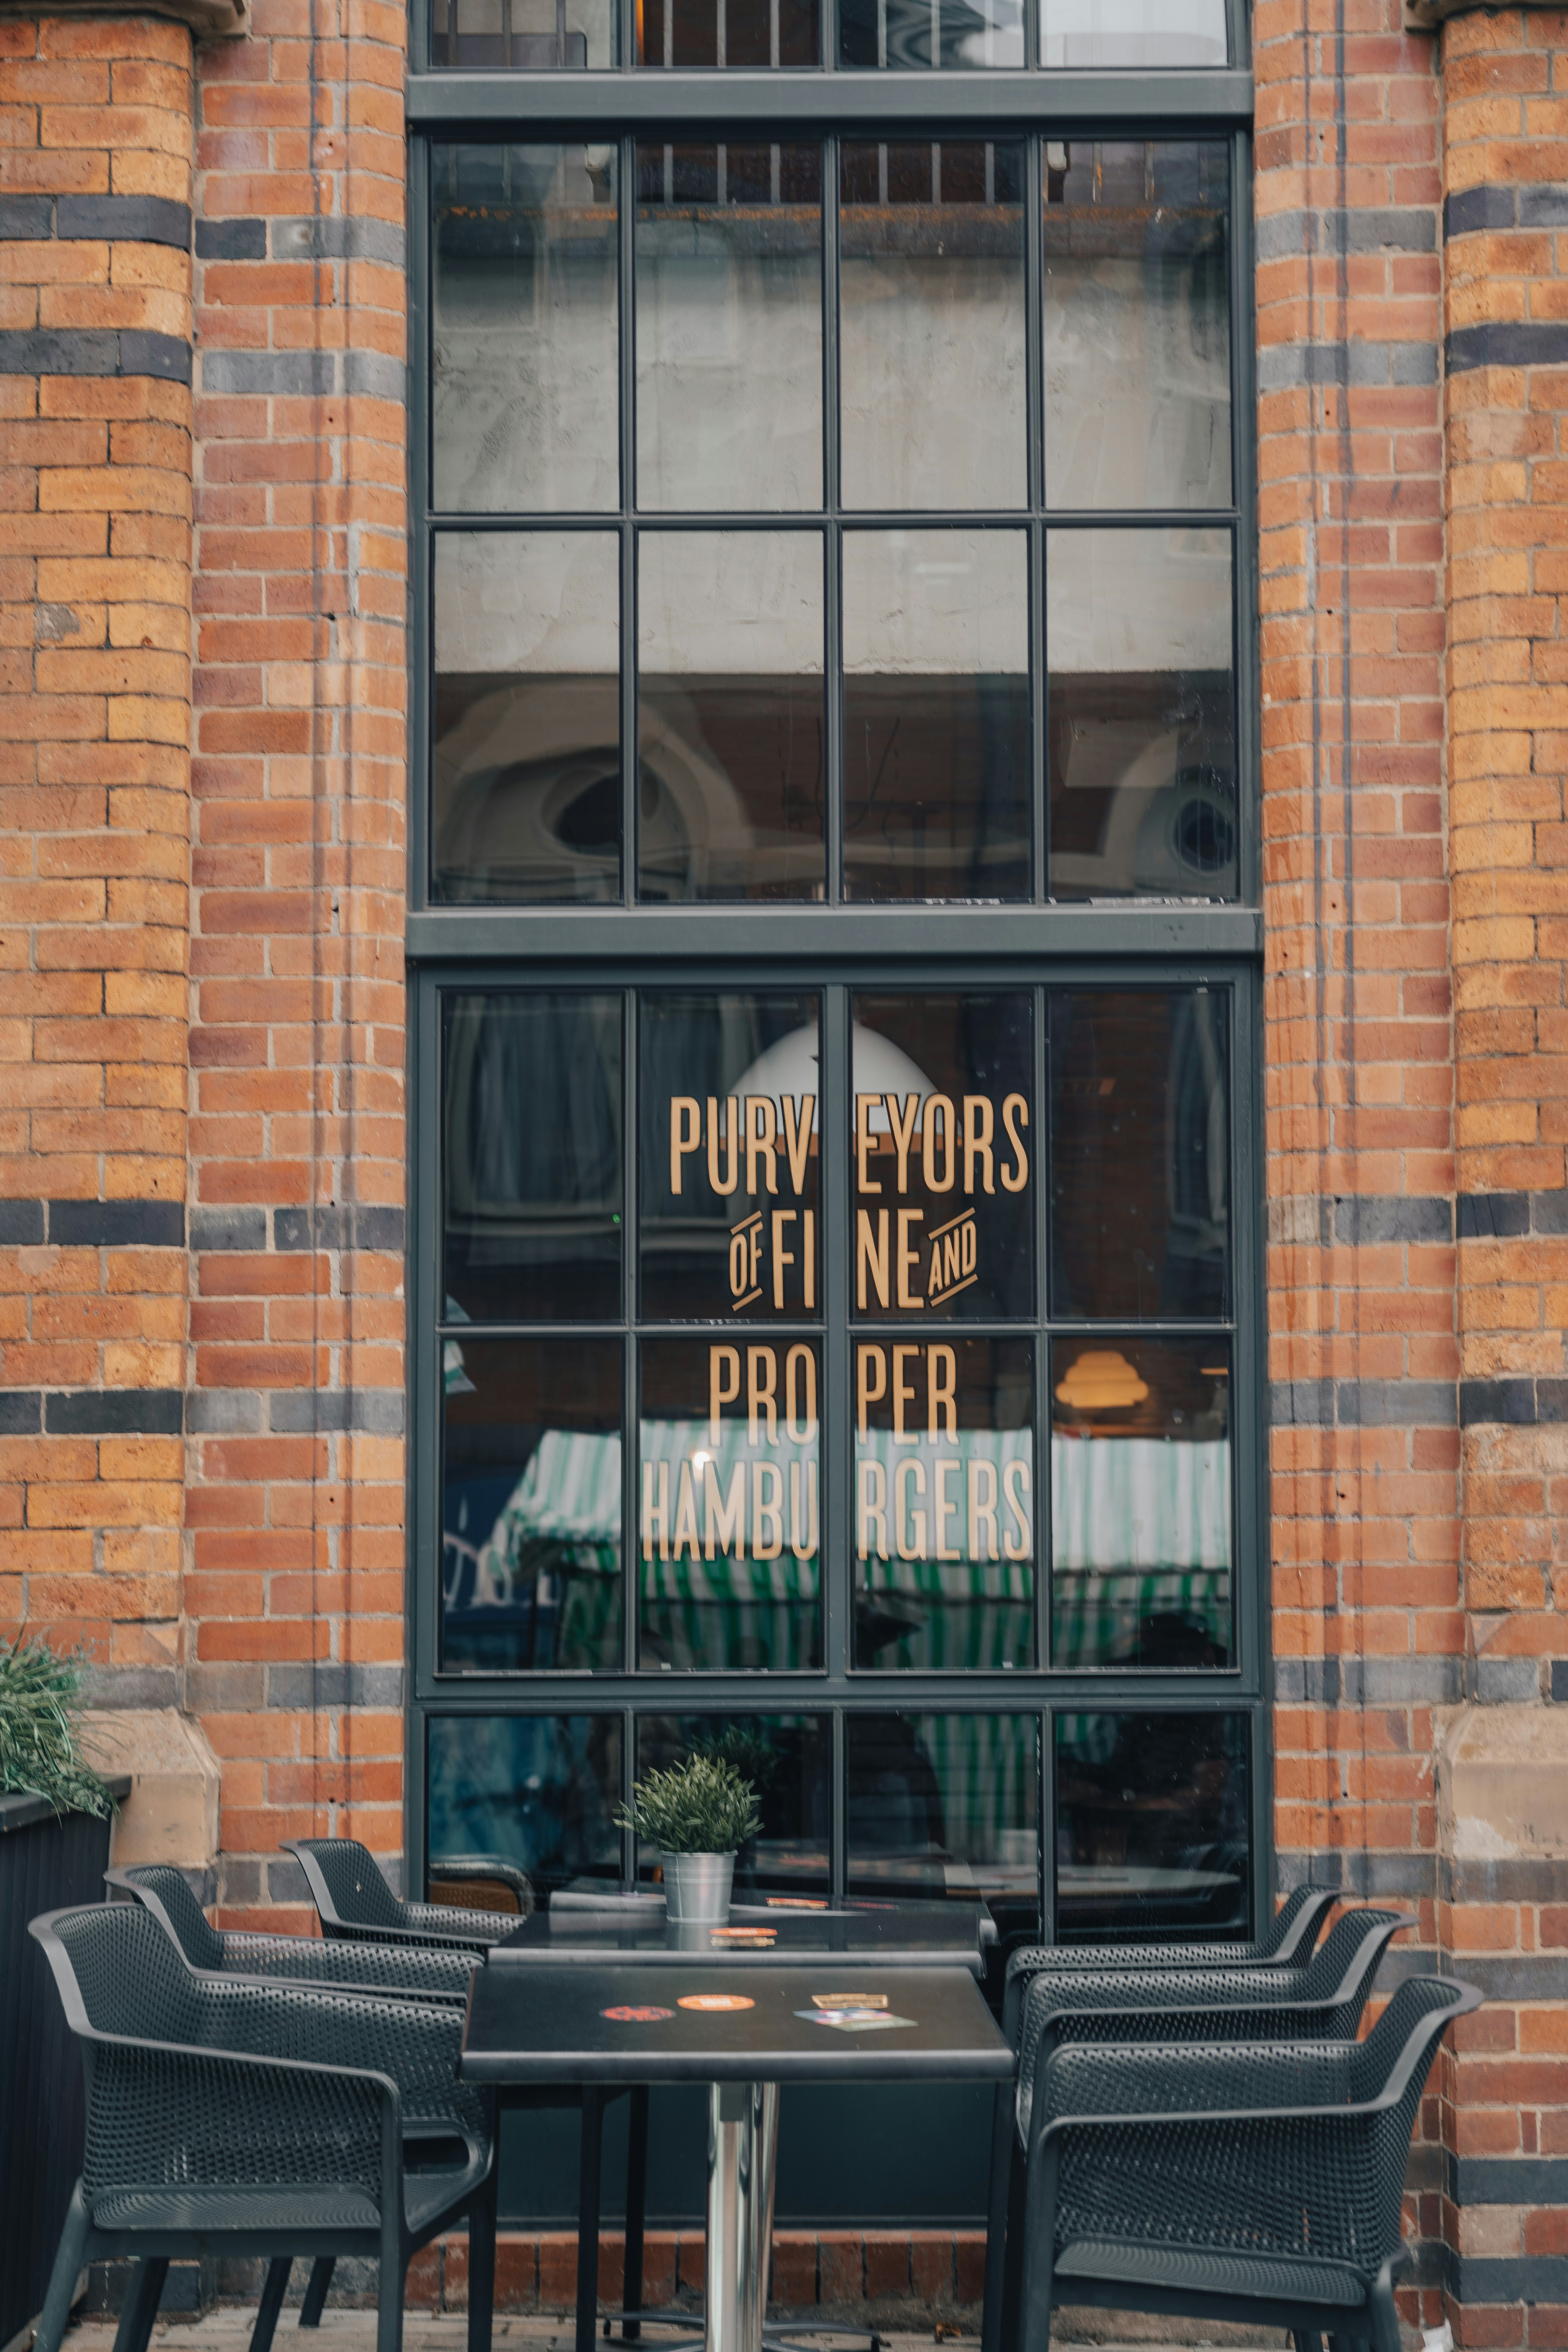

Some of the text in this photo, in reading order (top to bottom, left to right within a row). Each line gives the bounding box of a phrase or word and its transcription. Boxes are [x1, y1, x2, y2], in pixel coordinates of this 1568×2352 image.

[671, 1093, 1029, 1195] PURVEYORS
[730, 1209, 977, 1310] OF FINE AND
[710, 1344, 959, 1446] PROPER
[643, 1458, 1031, 1561] HAMBURGERS
